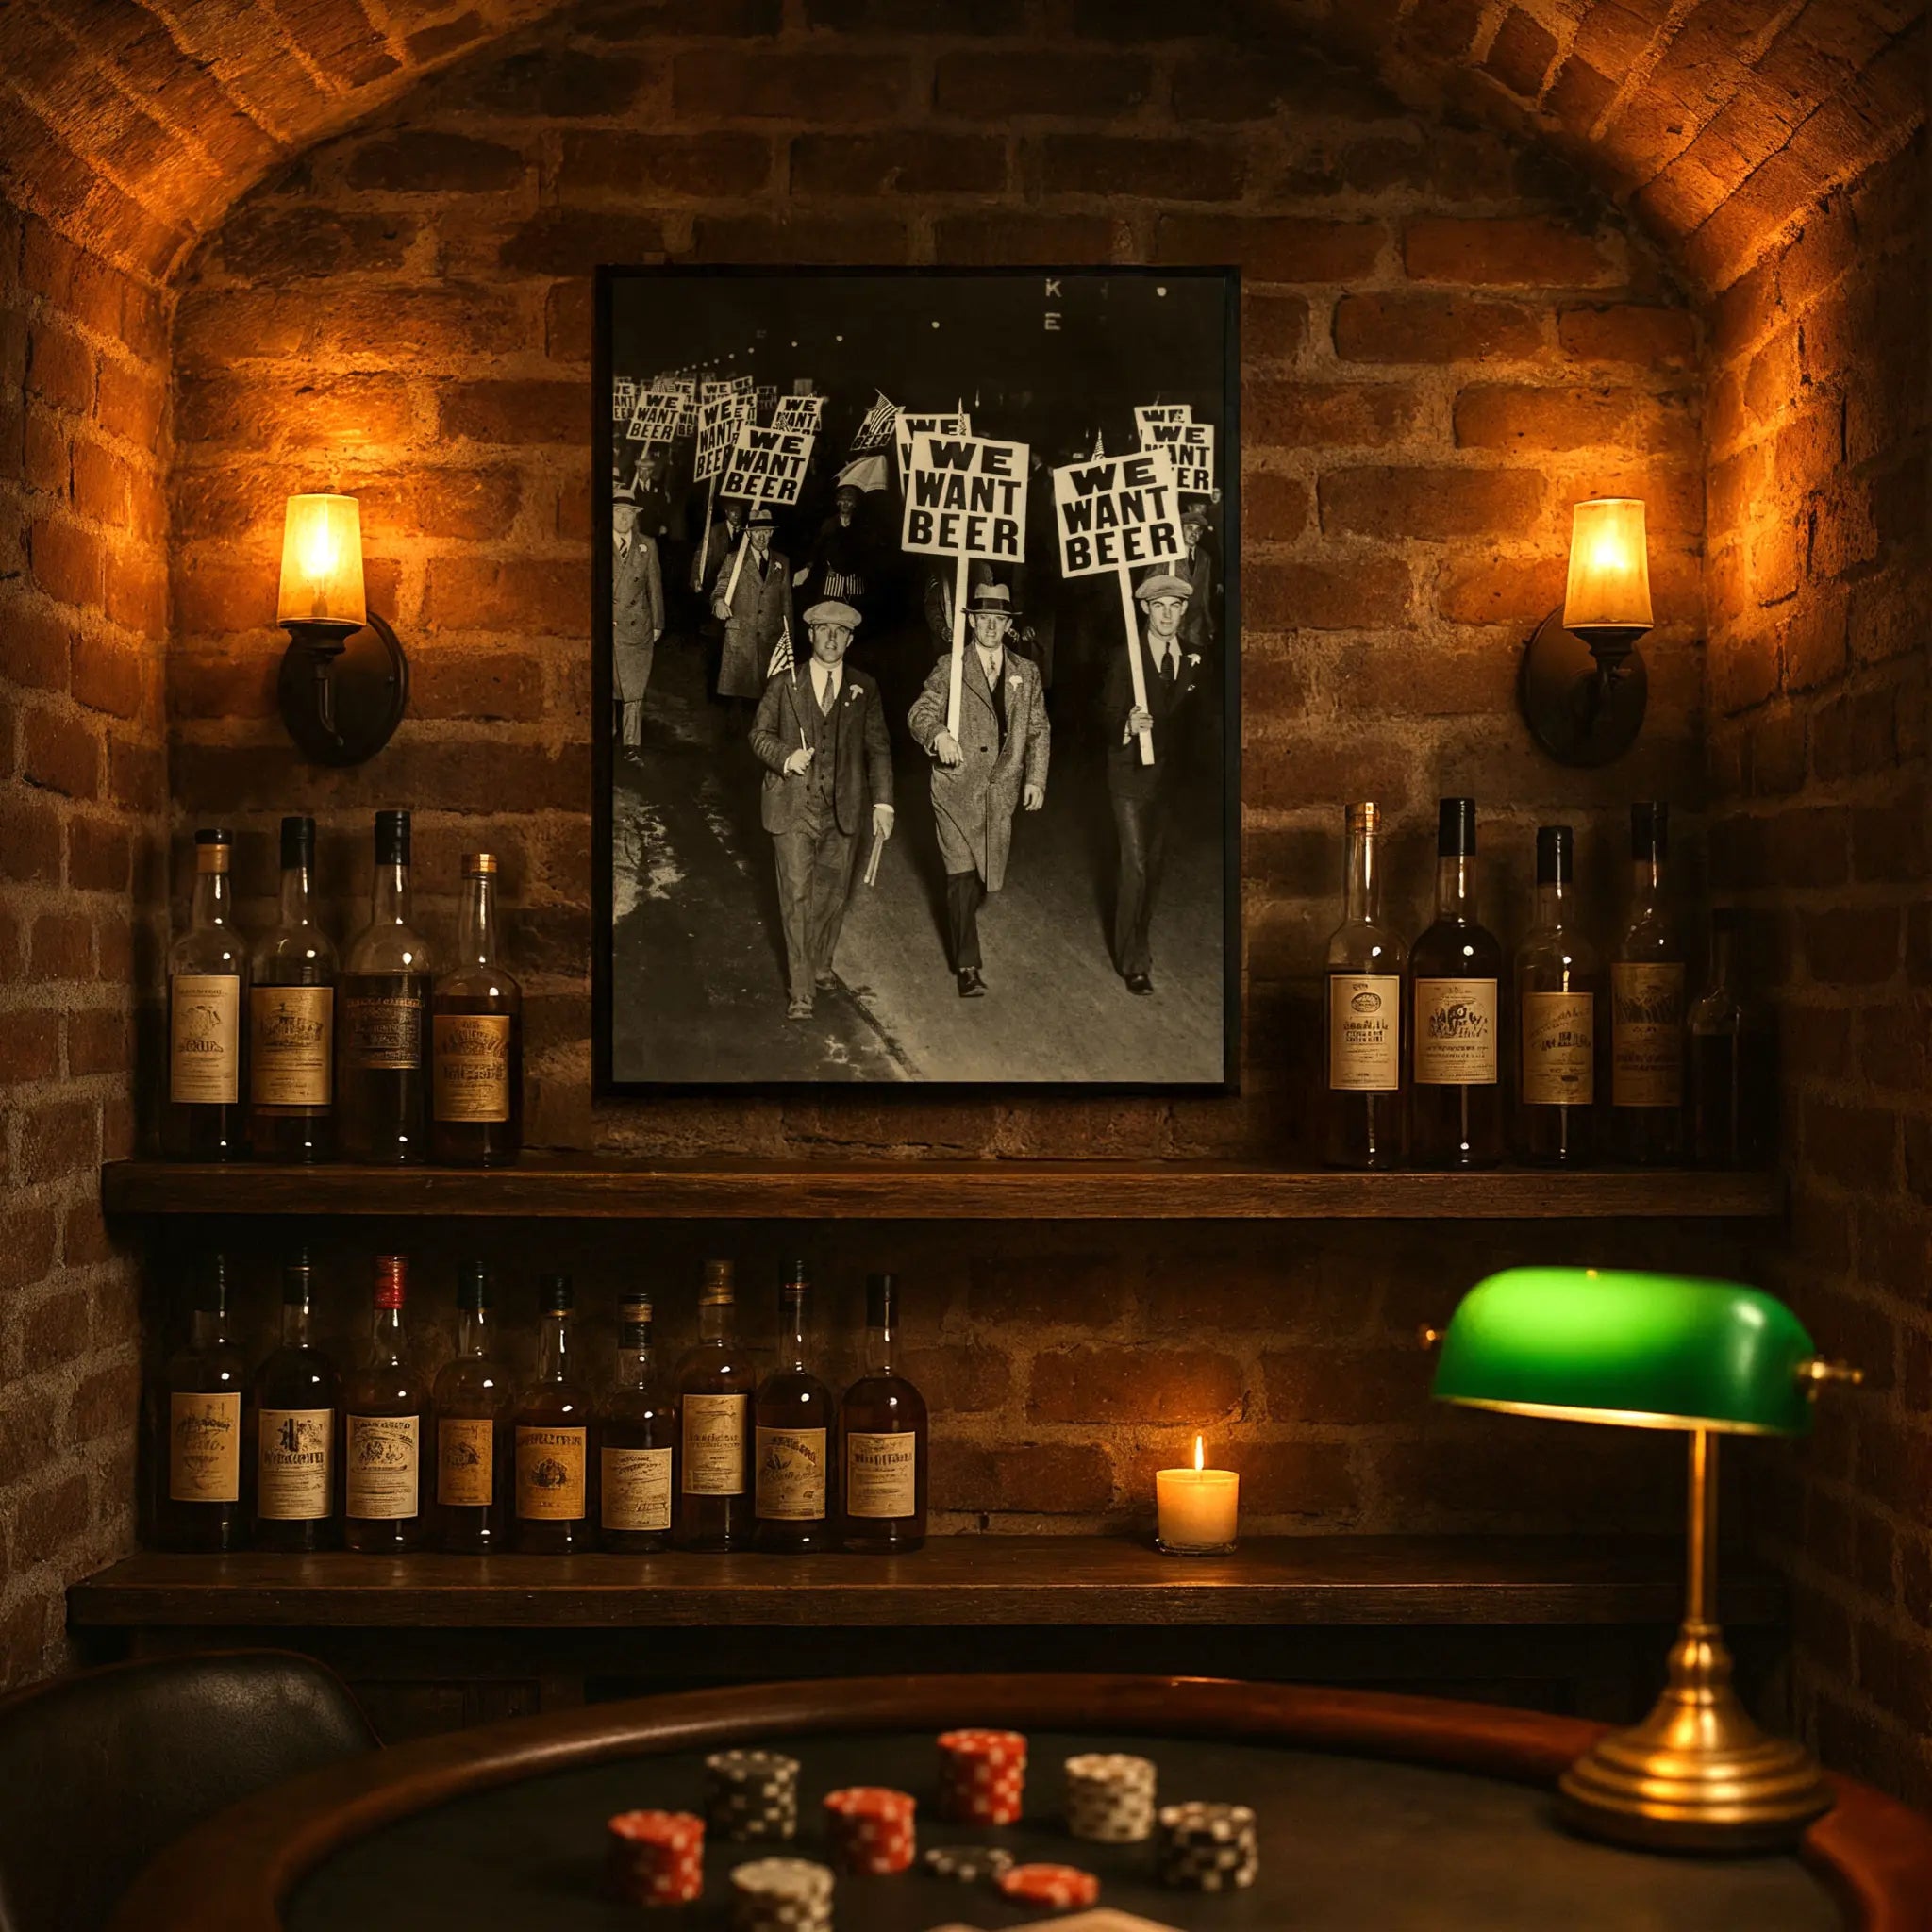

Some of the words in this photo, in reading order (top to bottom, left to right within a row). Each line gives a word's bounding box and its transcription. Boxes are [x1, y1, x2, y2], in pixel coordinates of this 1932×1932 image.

[646, 394, 679, 408] WE
[706, 384, 727, 393] WE
[637, 406, 679, 424] WANT
[704, 399, 732, 426] WE
[785, 399, 817, 412] WE
[630, 422, 674, 440] BEER
[699, 419, 734, 454] WANT
[859, 420, 895, 436] WNT
[905, 418, 960, 441] WE
[1152, 425, 1205, 444] WE
[750, 429, 804, 455] WE
[851, 434, 891, 449] BEER
[696, 443, 732, 479] BEER
[735, 448, 806, 478] WANT
[929, 439, 1013, 477] WE
[724, 472, 798, 500] BEER
[1069, 457, 1157, 497] WE
[1175, 467, 1209, 490] ER
[915, 469, 1022, 516] WANT
[1062, 485, 1169, 535] WANT
[908, 508, 1019, 557] BEER
[1065, 522, 1178, 572] BEER
